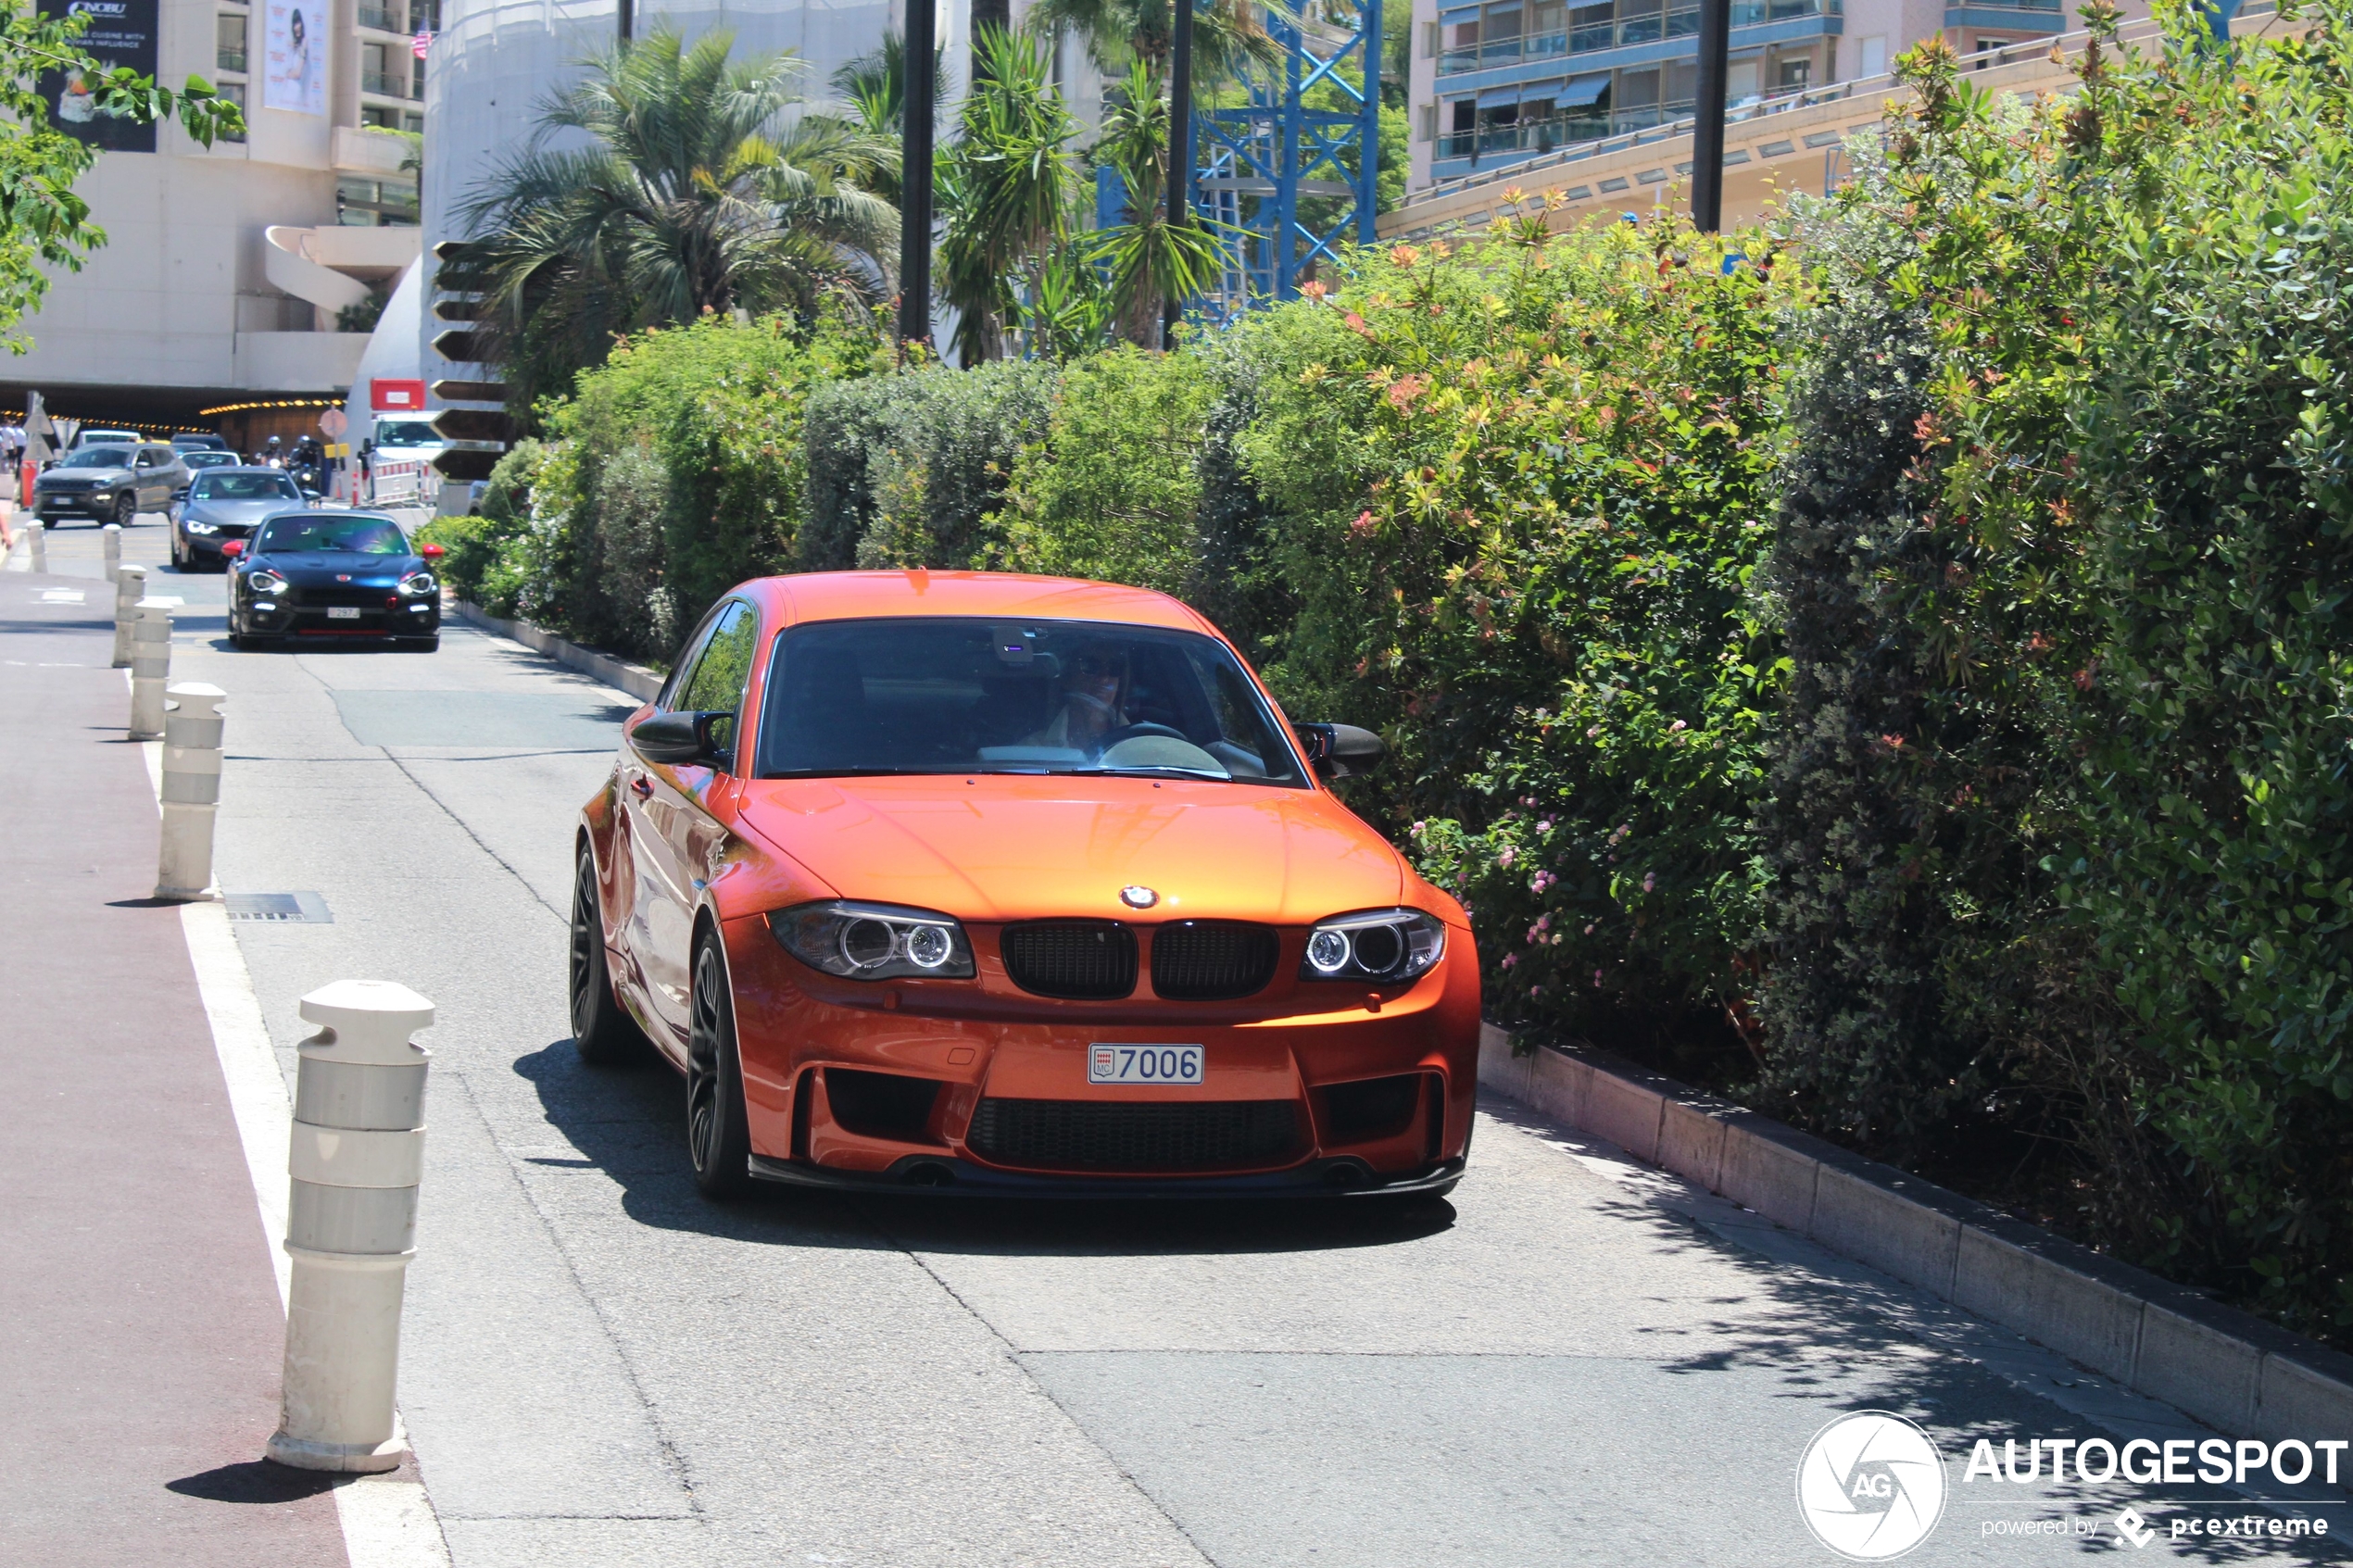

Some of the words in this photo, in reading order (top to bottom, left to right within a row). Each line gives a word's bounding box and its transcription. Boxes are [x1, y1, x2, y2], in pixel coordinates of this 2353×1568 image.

[83, 2, 127, 14] NOBU
[91, 31, 122, 40] CUISINE
[95, 40, 139, 48] INFLUENCE
[1097, 1064, 1110, 1073] MC
[1119, 1049, 1197, 1079] 7006
